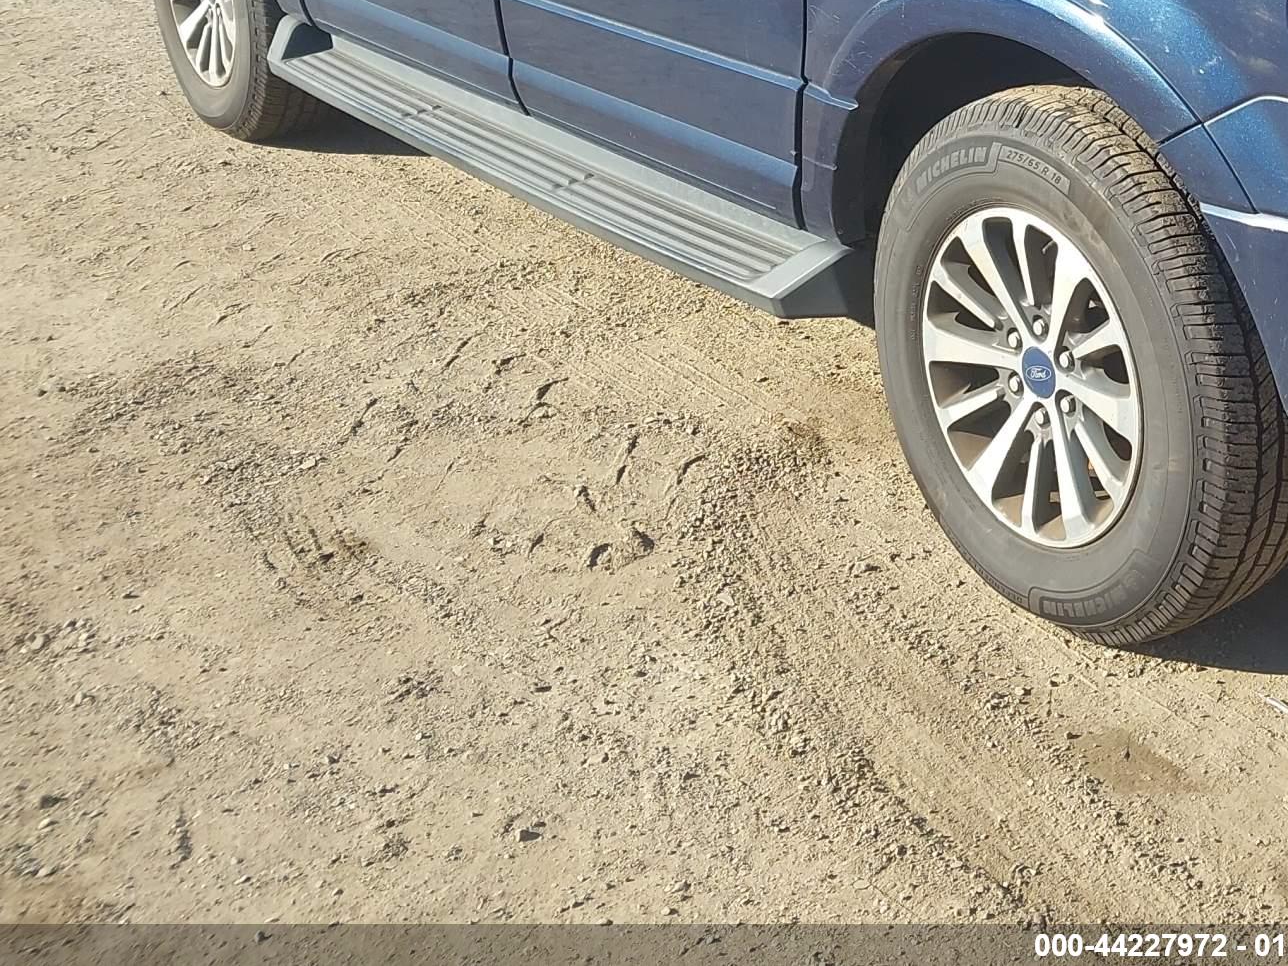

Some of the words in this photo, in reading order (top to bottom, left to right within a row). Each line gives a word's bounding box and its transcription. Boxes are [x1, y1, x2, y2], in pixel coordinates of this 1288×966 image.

[916, 146, 988, 194] MICHELIN
[1006, 149, 1041, 170] 275/65
[1041, 166, 1050, 176] R
[1050, 172, 1062, 185] 18
[1030, 367, 1047, 379] Ford
[1042, 585, 1127, 618] MICHELIN
